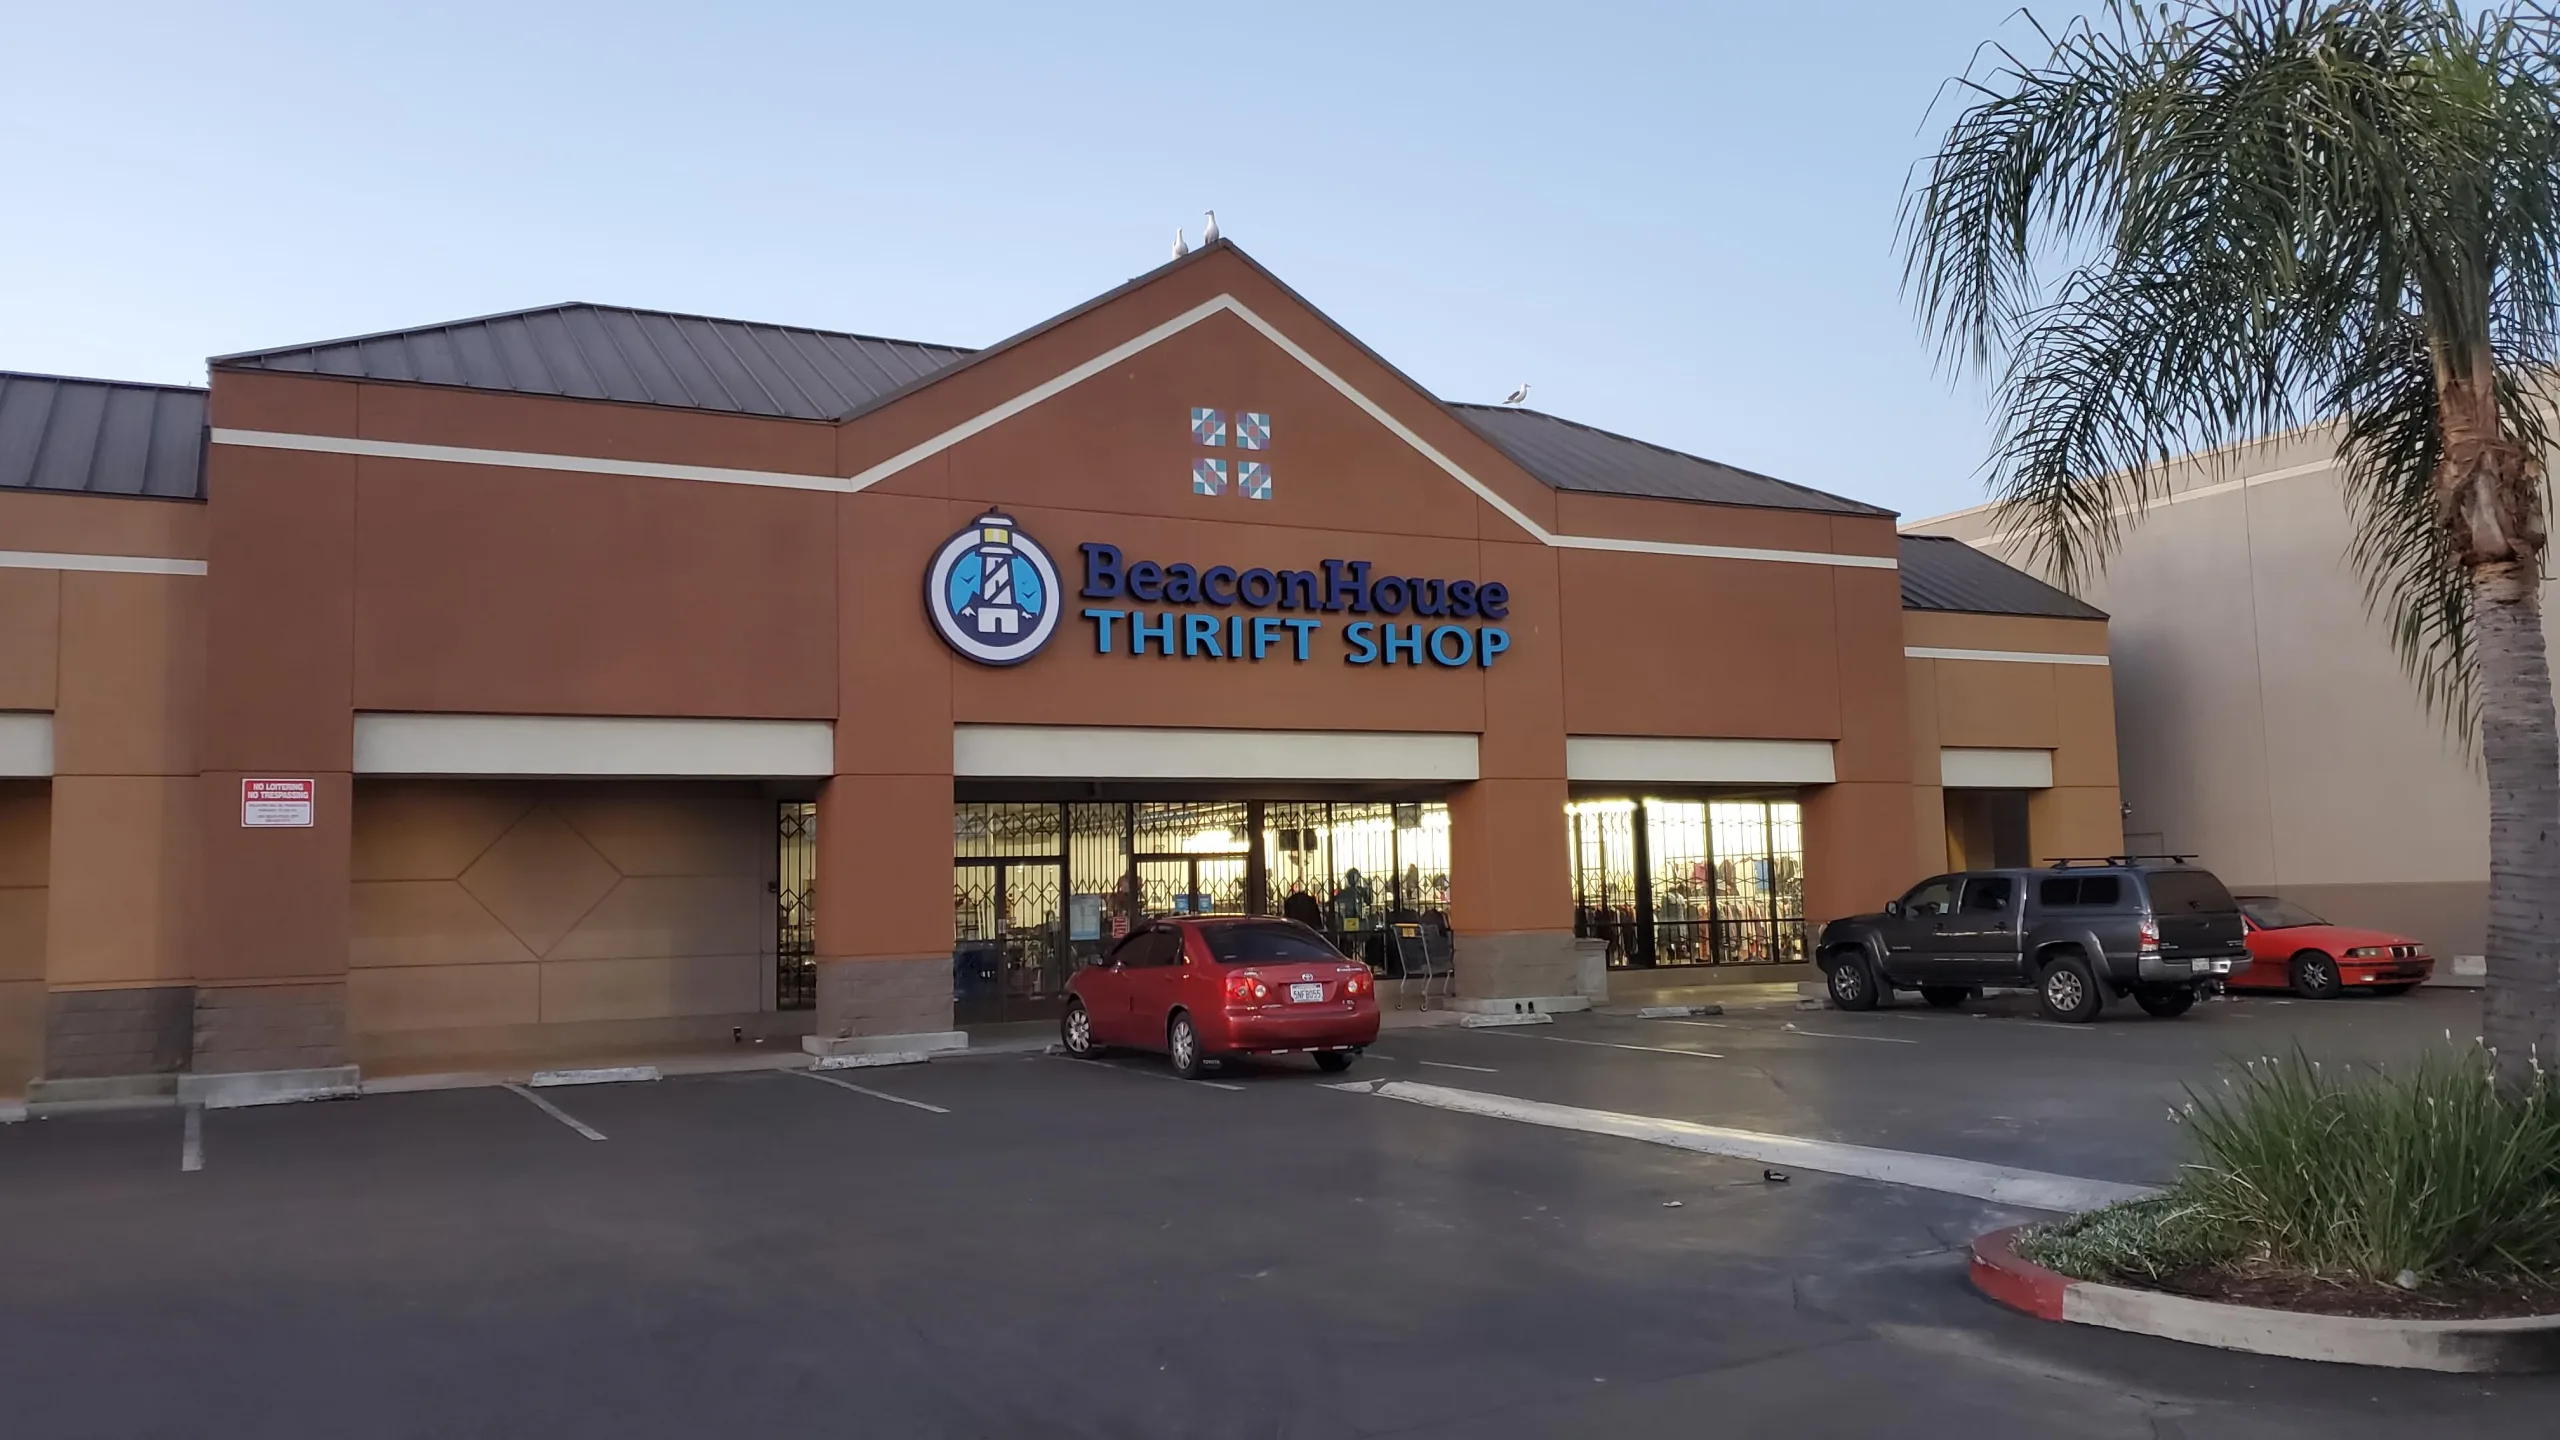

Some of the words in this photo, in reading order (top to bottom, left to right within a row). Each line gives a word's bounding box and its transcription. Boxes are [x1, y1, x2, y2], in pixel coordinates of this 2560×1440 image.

[1080, 542, 1510, 618] BeaconHouse
[1084, 608, 1321, 662] THRIFT
[1344, 620, 1511, 667] SHOP
